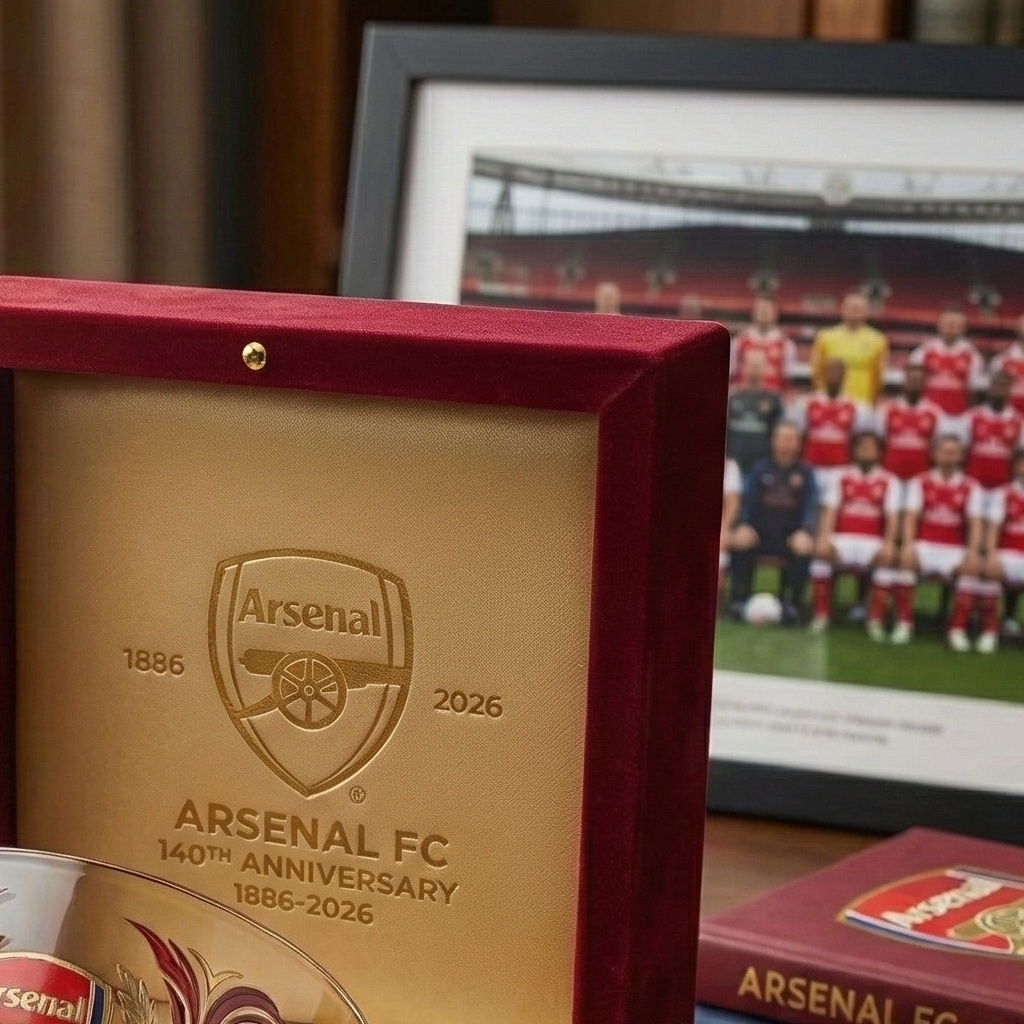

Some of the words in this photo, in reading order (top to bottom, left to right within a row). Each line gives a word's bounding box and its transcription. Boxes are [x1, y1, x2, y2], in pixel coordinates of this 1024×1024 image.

[238, 587, 381, 638] Arsenal
[123, 647, 185, 677] 1886
[433, 687, 503, 719] 2026
[174, 799, 380, 860] ARSENAL
[394, 830, 449, 869] FC
[158, 839, 232, 867] 140TH
[241, 851, 459, 905] ANNIVERSARY
[234, 882, 375, 925] 1886-2026
